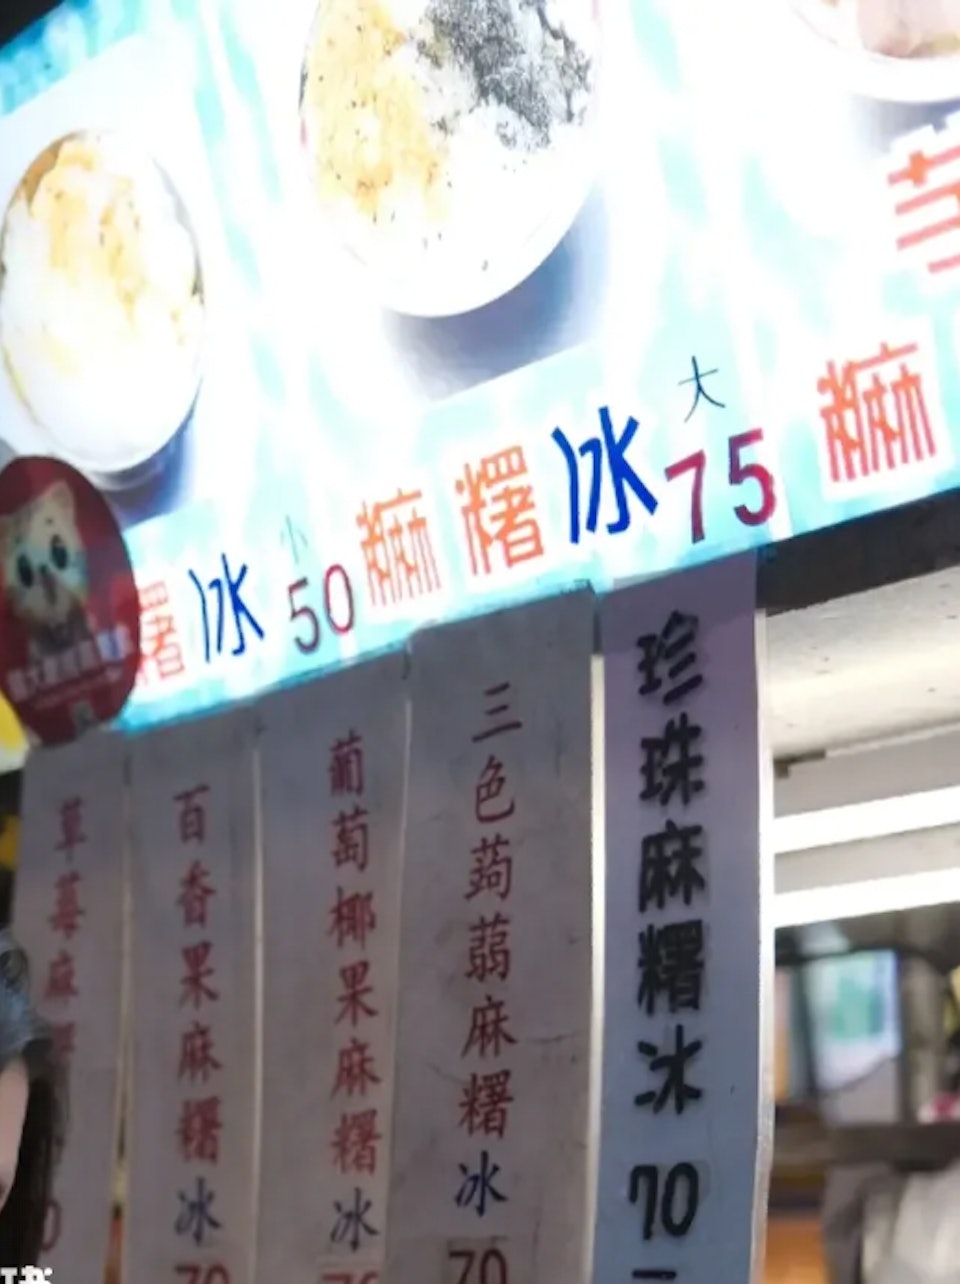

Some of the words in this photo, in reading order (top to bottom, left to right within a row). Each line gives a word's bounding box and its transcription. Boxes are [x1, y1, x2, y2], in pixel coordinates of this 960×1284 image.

[677, 355, 726, 424] 大
[664, 427, 776, 544] 75
[287, 563, 355, 656] 50
[635, 610, 706, 1115] 珍珠麻糬冰
[454, 681, 523, 1218] 三色蒟蒻麻糬冰
